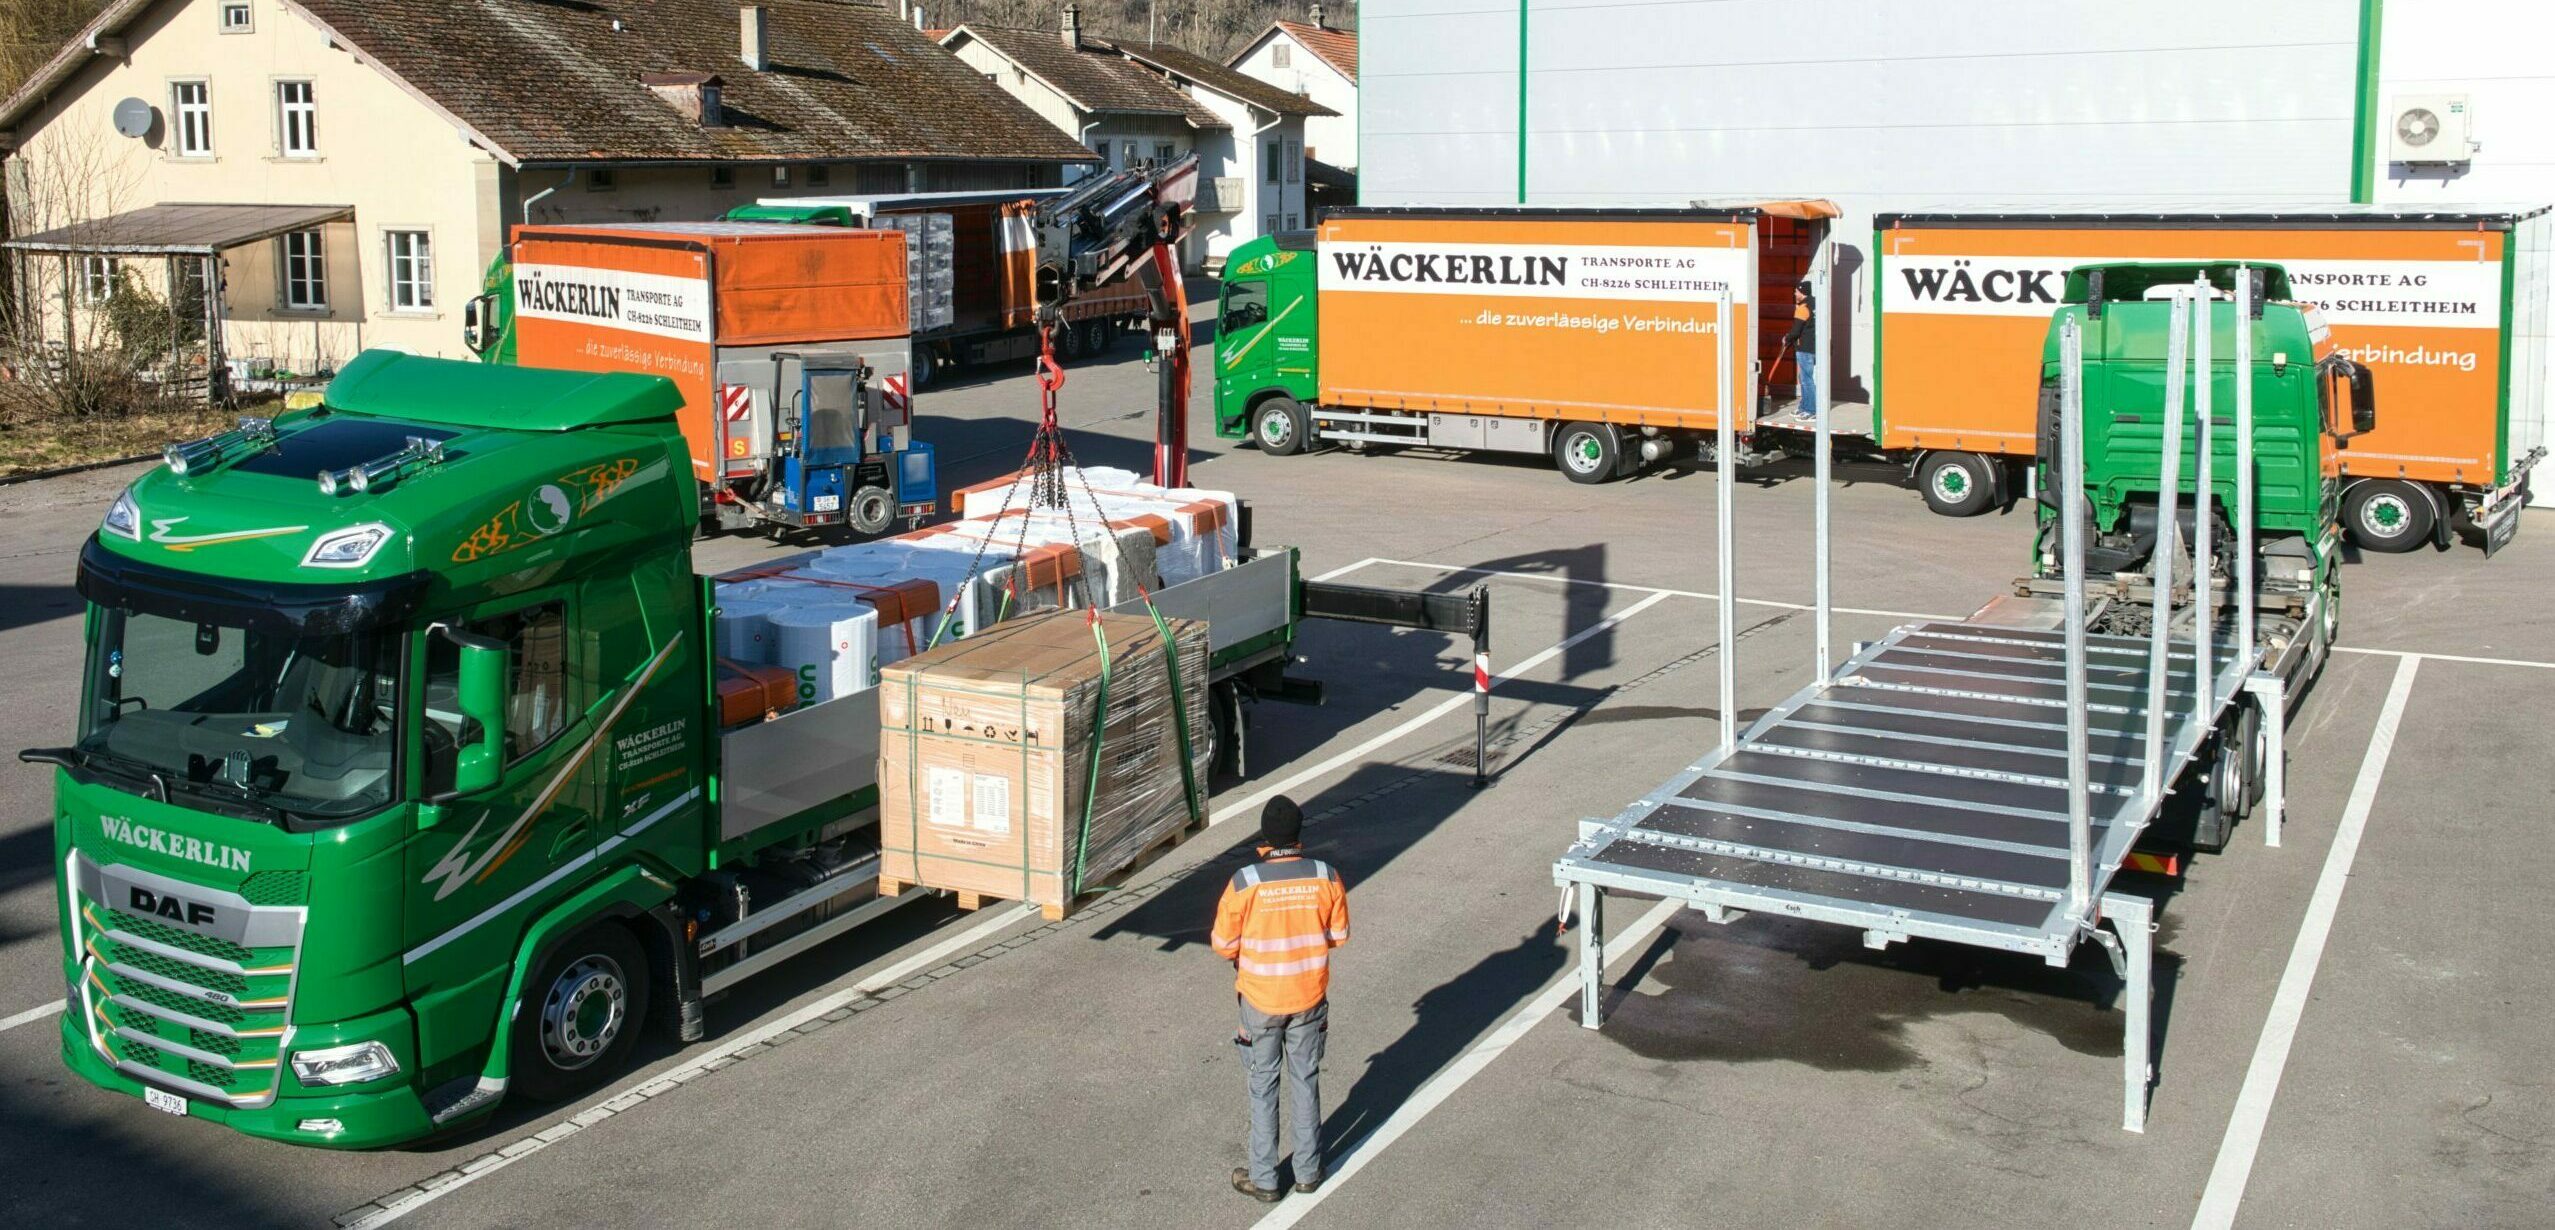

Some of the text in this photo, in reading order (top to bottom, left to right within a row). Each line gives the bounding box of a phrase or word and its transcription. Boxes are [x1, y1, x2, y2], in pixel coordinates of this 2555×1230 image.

[1333, 245, 1568, 286] WÄCKERLIN
[1581, 256, 1696, 268] TRANSPORTE AG
[1900, 259, 2073, 304] WÄCK
[2287, 273, 2428, 287] ANSPORTE AG
[518, 270, 620, 319] WÄCKERLIN
[626, 288, 684, 308] TRANSPORTE AG
[2335, 300, 2477, 314] SCHLEITHEIM
[654, 314, 702, 332] SCHLEITHEIM
[1476, 310, 1501, 325] die
[1505, 312, 1620, 334] zuverlässige
[1623, 314, 1718, 335] Verbindun
[585, 341, 598, 356] die
[600, 343, 653, 370] zuverlässige
[654, 349, 705, 380] Verbindung
[2333, 343, 2477, 372] erbindung
[734, 440, 746, 456] S
[622, 732, 682, 759] TRANSPORTE AG
[100, 815, 252, 873] WÄCKERLIN
[130, 885, 216, 926] DAF
[204, 991, 229, 1002] 480
